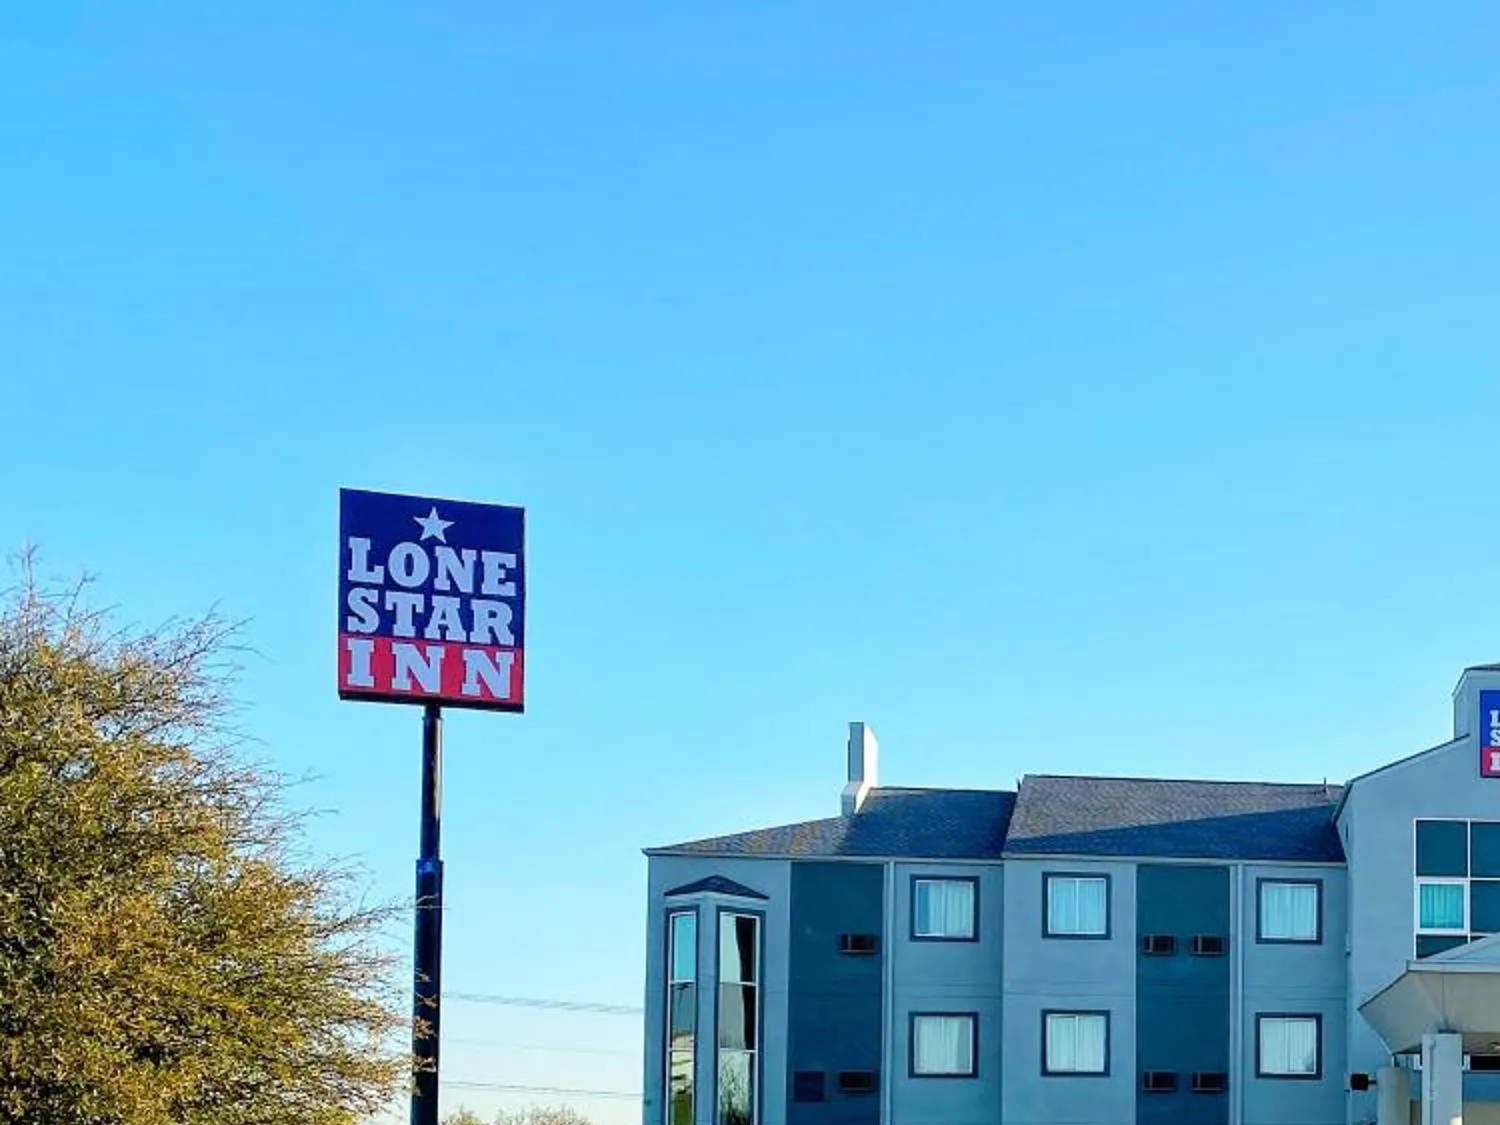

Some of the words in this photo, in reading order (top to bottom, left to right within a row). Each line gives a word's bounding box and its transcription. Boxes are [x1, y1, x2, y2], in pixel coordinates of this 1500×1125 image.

[347, 537, 516, 597] LONE
[347, 587, 514, 646] STAR
[347, 639, 514, 699] INN
